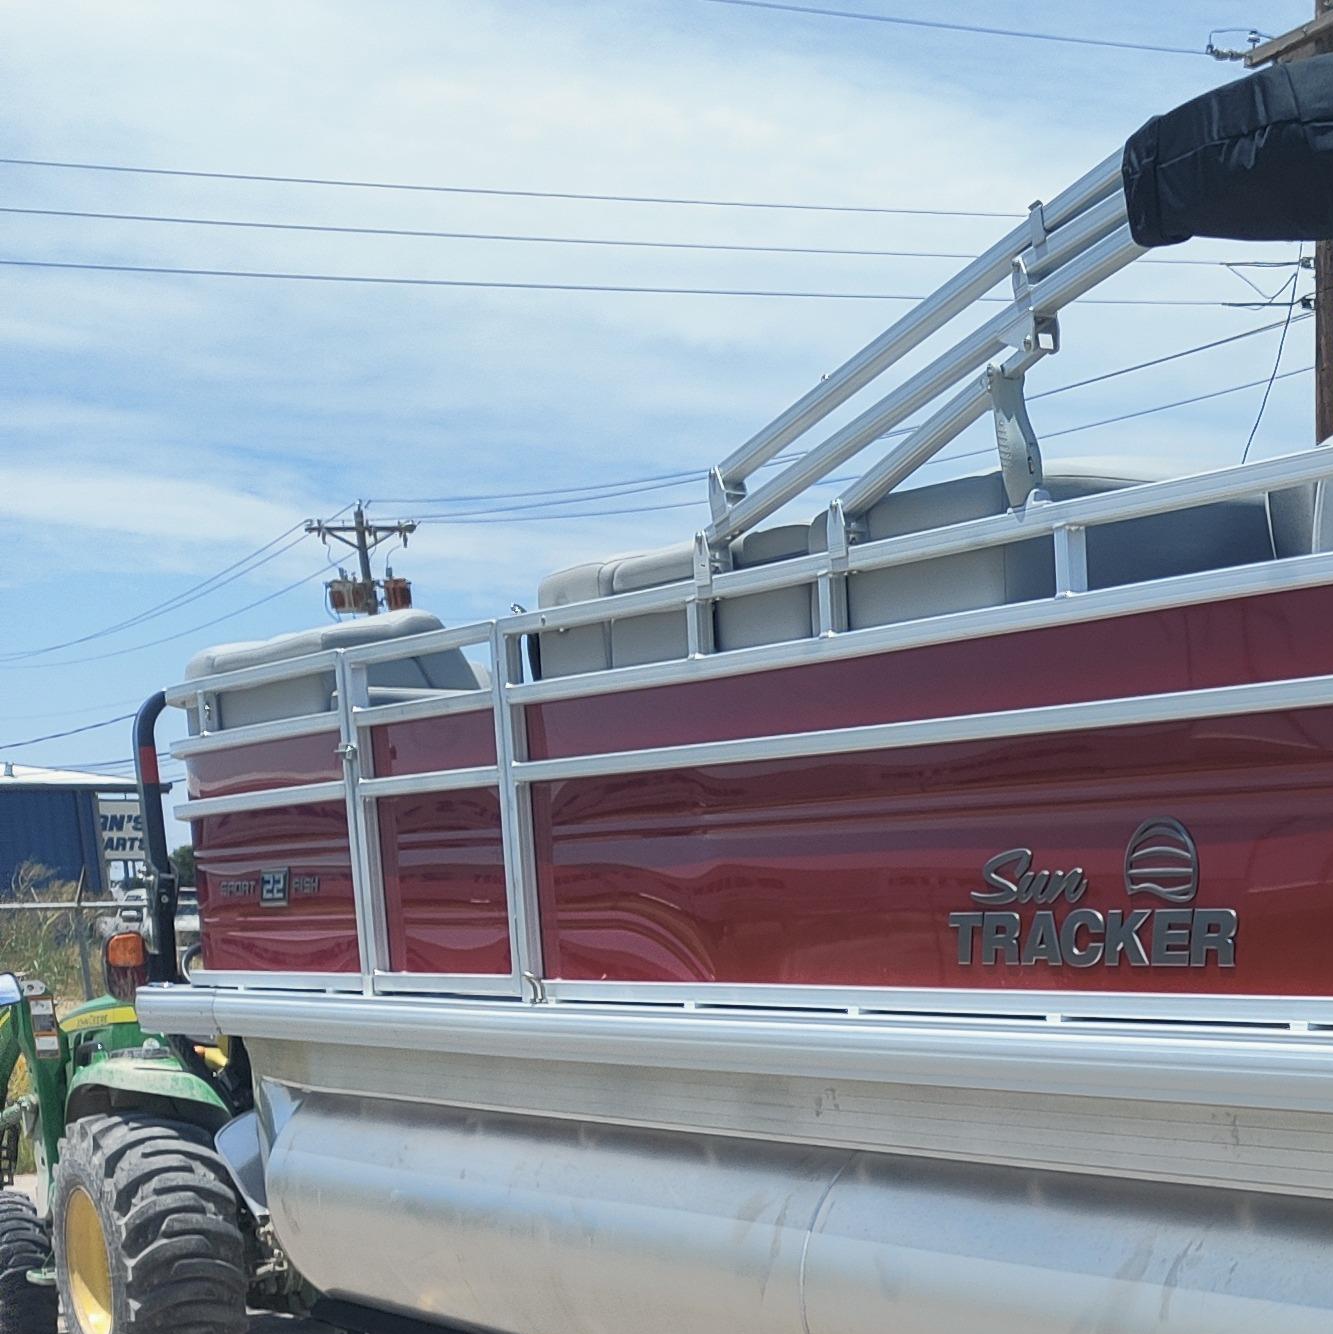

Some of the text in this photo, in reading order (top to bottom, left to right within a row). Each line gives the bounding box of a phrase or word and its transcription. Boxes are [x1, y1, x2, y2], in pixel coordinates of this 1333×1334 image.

[219, 872, 320, 900] SPORT 22 FISH
[970, 847, 1088, 906] Sun
[948, 906, 1238, 968] TRACKER
